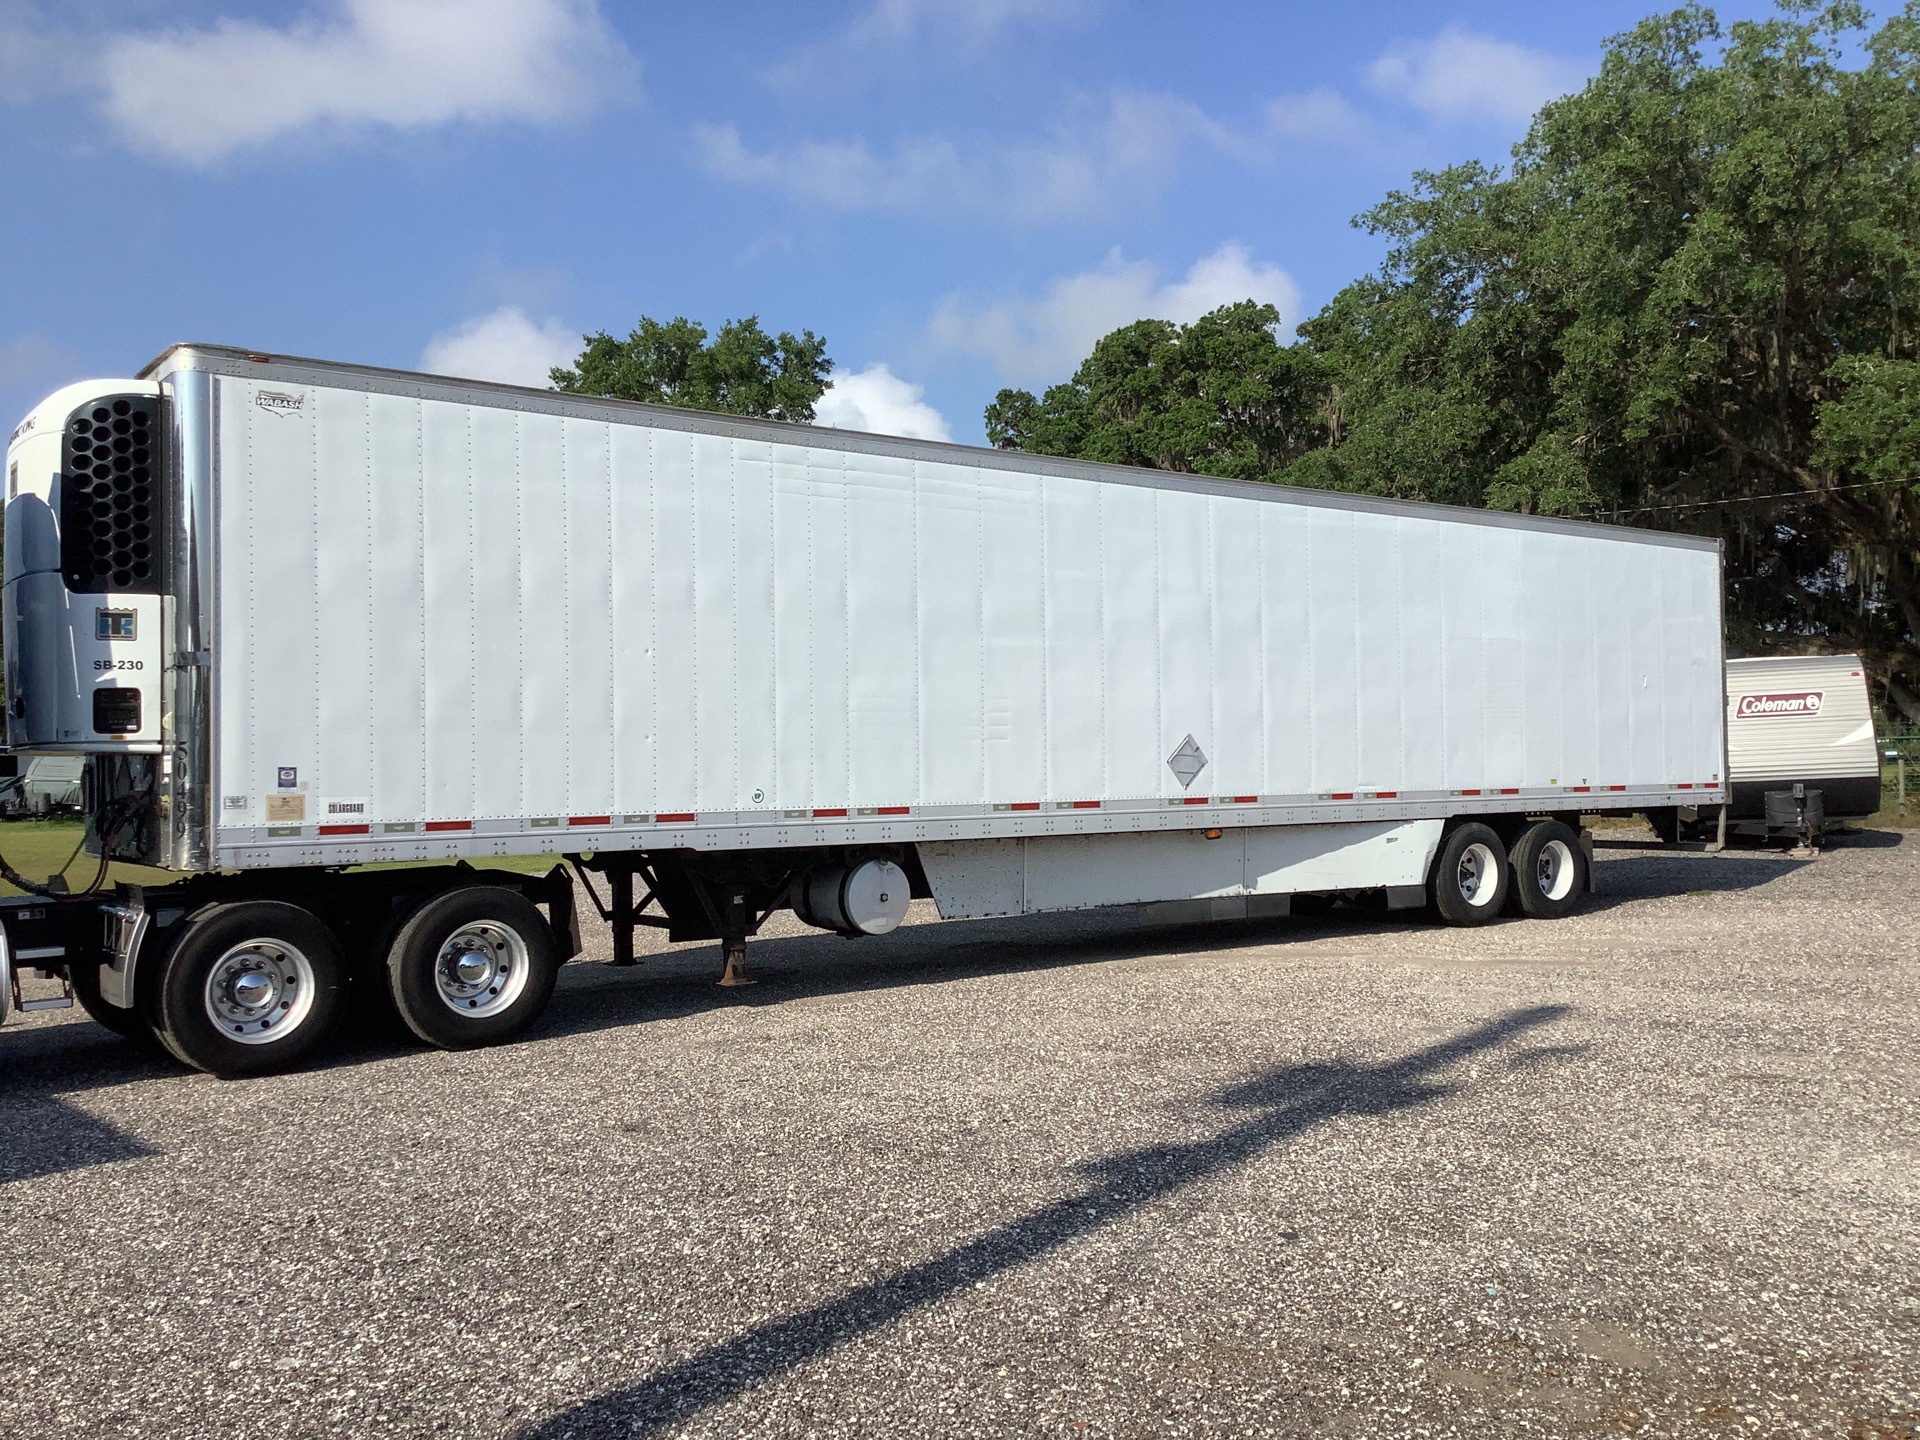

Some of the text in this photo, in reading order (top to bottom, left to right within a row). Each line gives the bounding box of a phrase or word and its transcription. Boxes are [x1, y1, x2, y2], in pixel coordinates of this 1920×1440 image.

[256, 397, 303, 409] WABASH
[93, 660, 144, 670] SB-230
[1741, 696, 1805, 713] Coleman
[177, 741, 188, 840] 50499
[328, 803, 364, 813] SOLARGUARD
